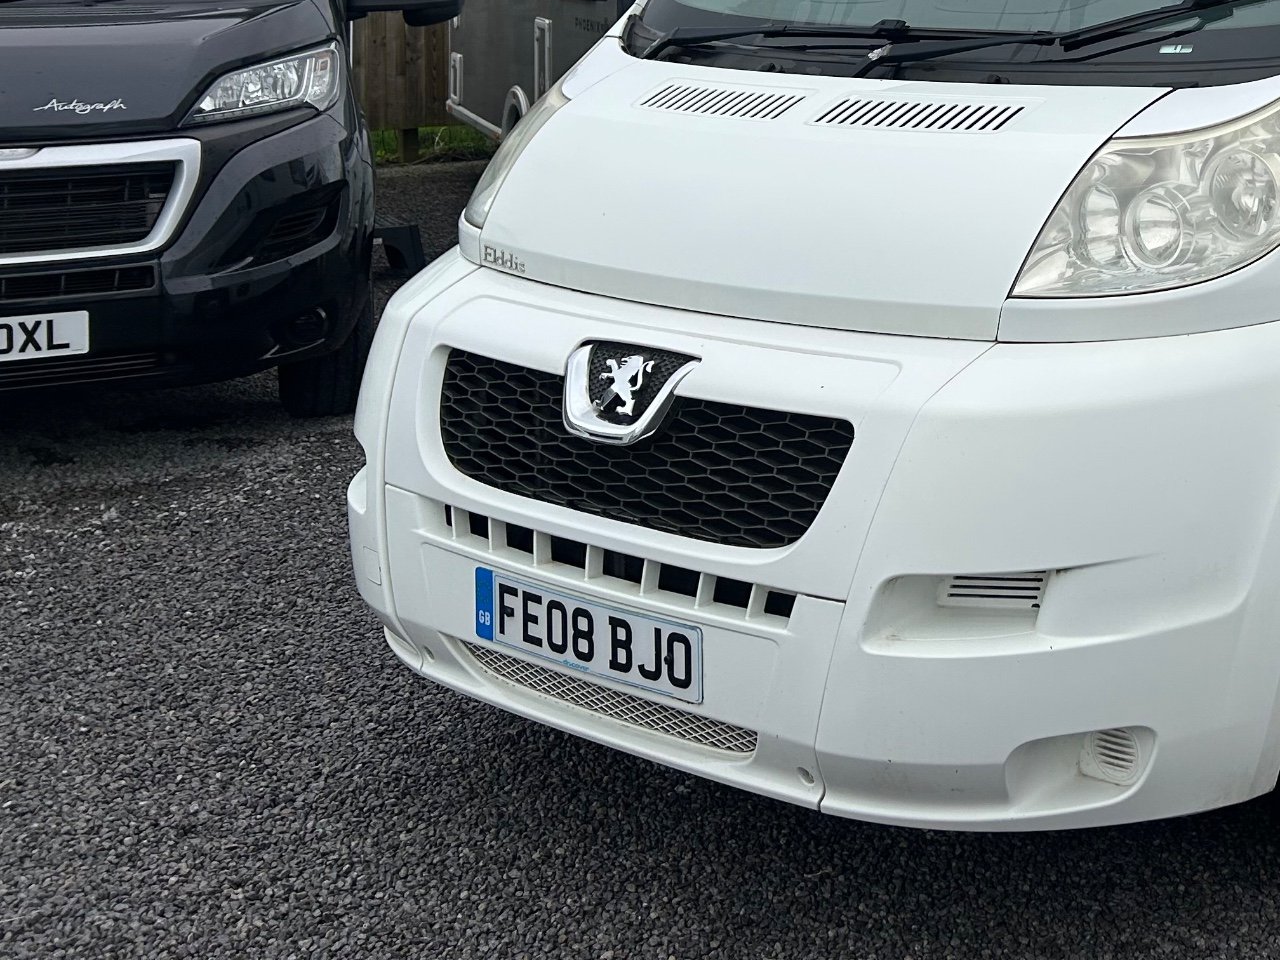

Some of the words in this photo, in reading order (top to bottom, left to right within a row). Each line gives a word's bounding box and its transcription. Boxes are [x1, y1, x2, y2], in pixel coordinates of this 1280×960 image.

[32, 98, 127, 114] Autograph
[478, 609, 491, 626] GB
[498, 582, 594, 663] FE08
[608, 615, 692, 689] BJO
